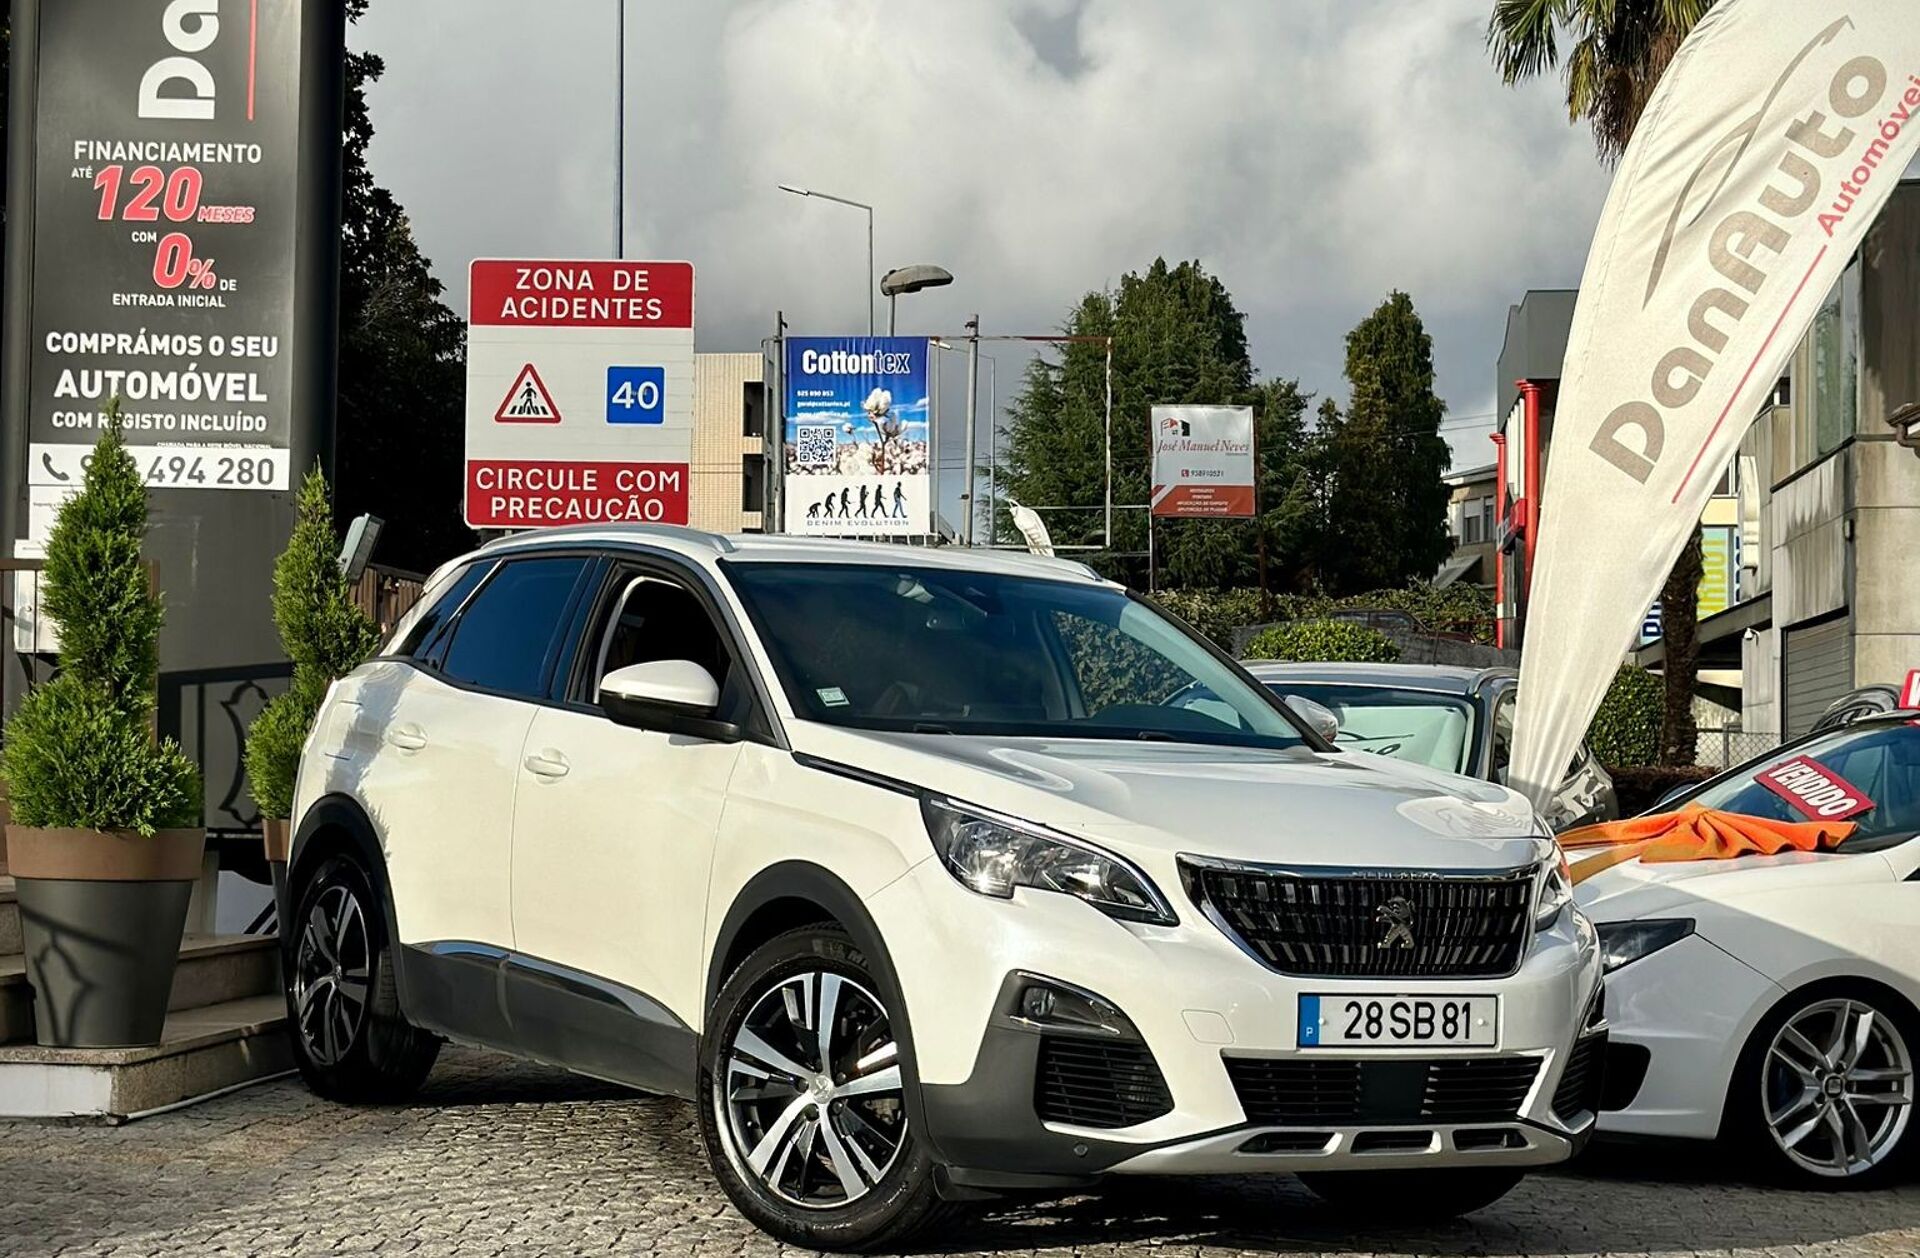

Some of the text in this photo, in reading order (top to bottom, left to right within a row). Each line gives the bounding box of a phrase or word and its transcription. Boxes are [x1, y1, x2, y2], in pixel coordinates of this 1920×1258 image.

[73, 140, 262, 164] FINANCIAMENTO
[71, 165, 255, 223] ATÉ 120 MESES
[131, 231, 237, 292] COM 0% DE
[1589, 55, 1888, 485] DanAuto
[516, 268, 649, 292] ZONA DE
[112, 293, 226, 308] ENTRADA INICIAL
[501, 297, 662, 320] ACIDENTES
[45, 328, 278, 358] COMPRÁMOS O SEU
[802, 349, 911, 375] Cottontex
[53, 363, 268, 402] AUTOMÓVEL
[612, 380, 659, 410] 40
[52, 411, 93, 429] COM
[180, 410, 267, 432] INCLUÍDO
[1157, 440, 1177, 453] José
[1179, 439, 1220, 452] Manuel
[147, 455, 206, 484] 494
[216, 457, 275, 486] 280
[475, 467, 680, 492] CIRCULE COM
[490, 495, 664, 523] PRECAUÇÃO
[1767, 761, 1858, 817] VENDIDO
[1306, 1027, 1313, 1037] P
[1344, 1001, 1471, 1040] 28 SB 81
